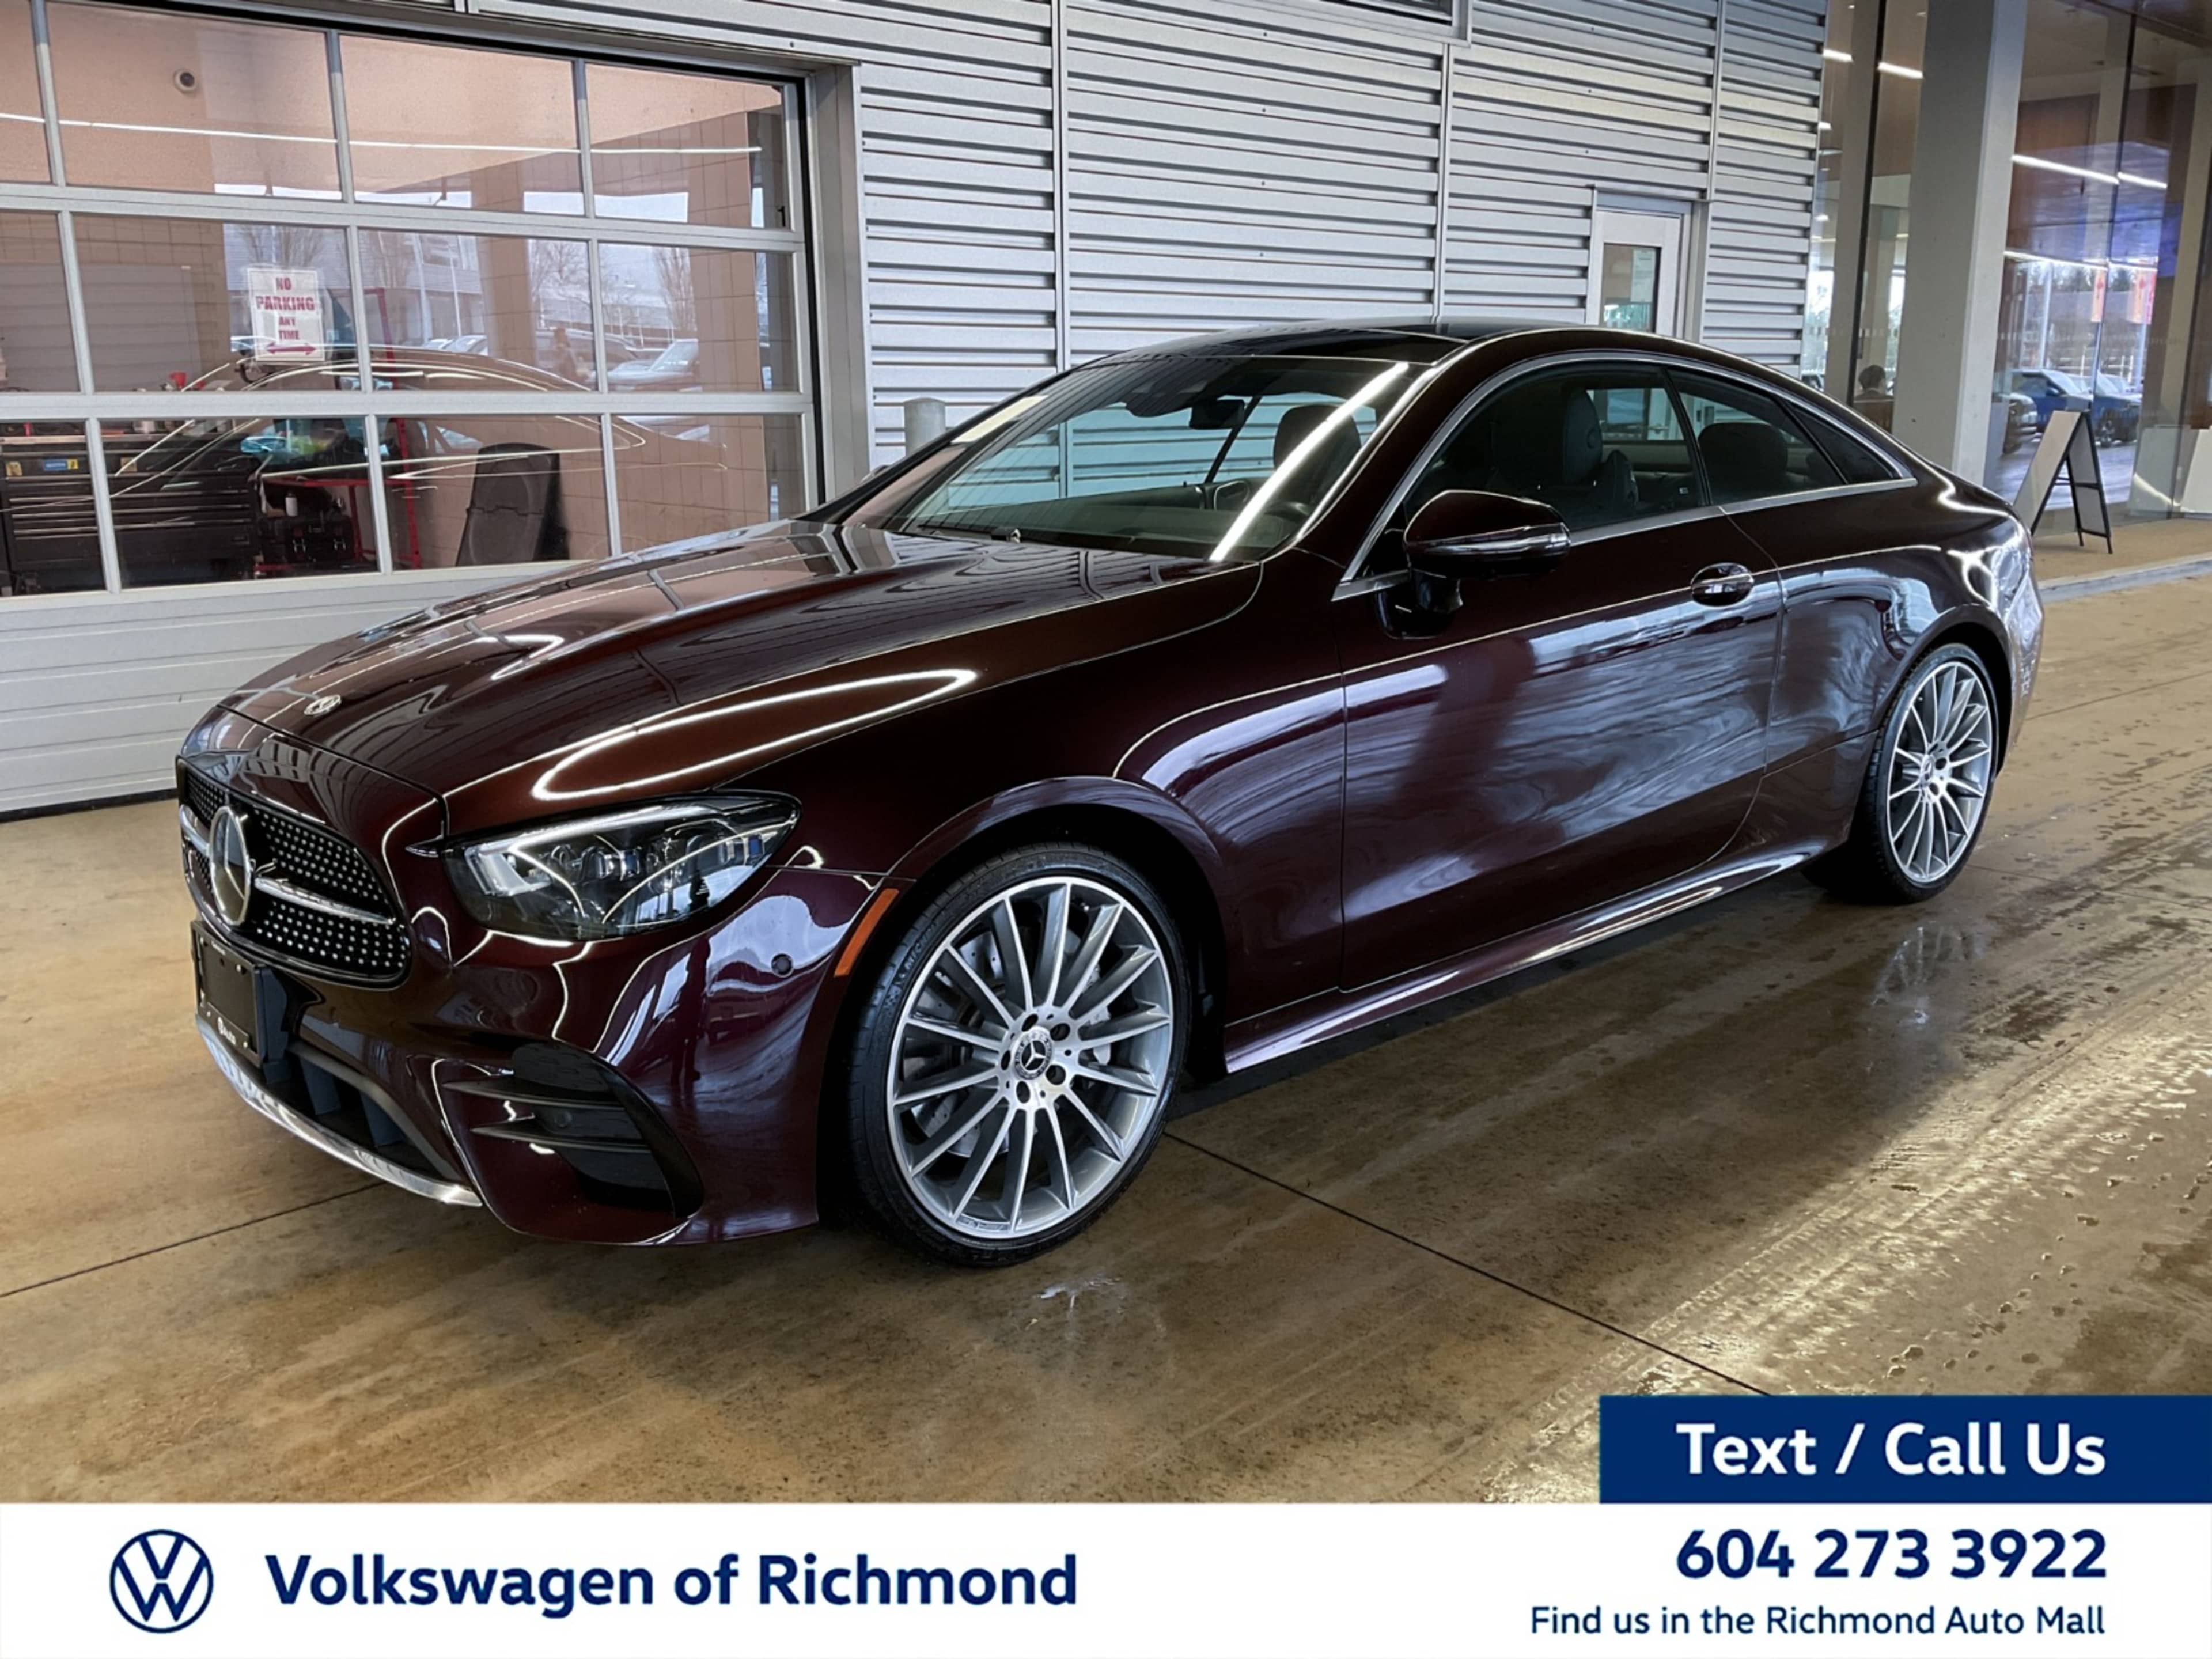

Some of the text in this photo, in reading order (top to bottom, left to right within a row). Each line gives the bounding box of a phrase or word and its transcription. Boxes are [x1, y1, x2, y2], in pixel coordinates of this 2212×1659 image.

[276, 277, 292, 290] NO
[255, 296, 315, 311] PARKING
[278, 316, 296, 326] ANY
[278, 330, 300, 340] TIME
